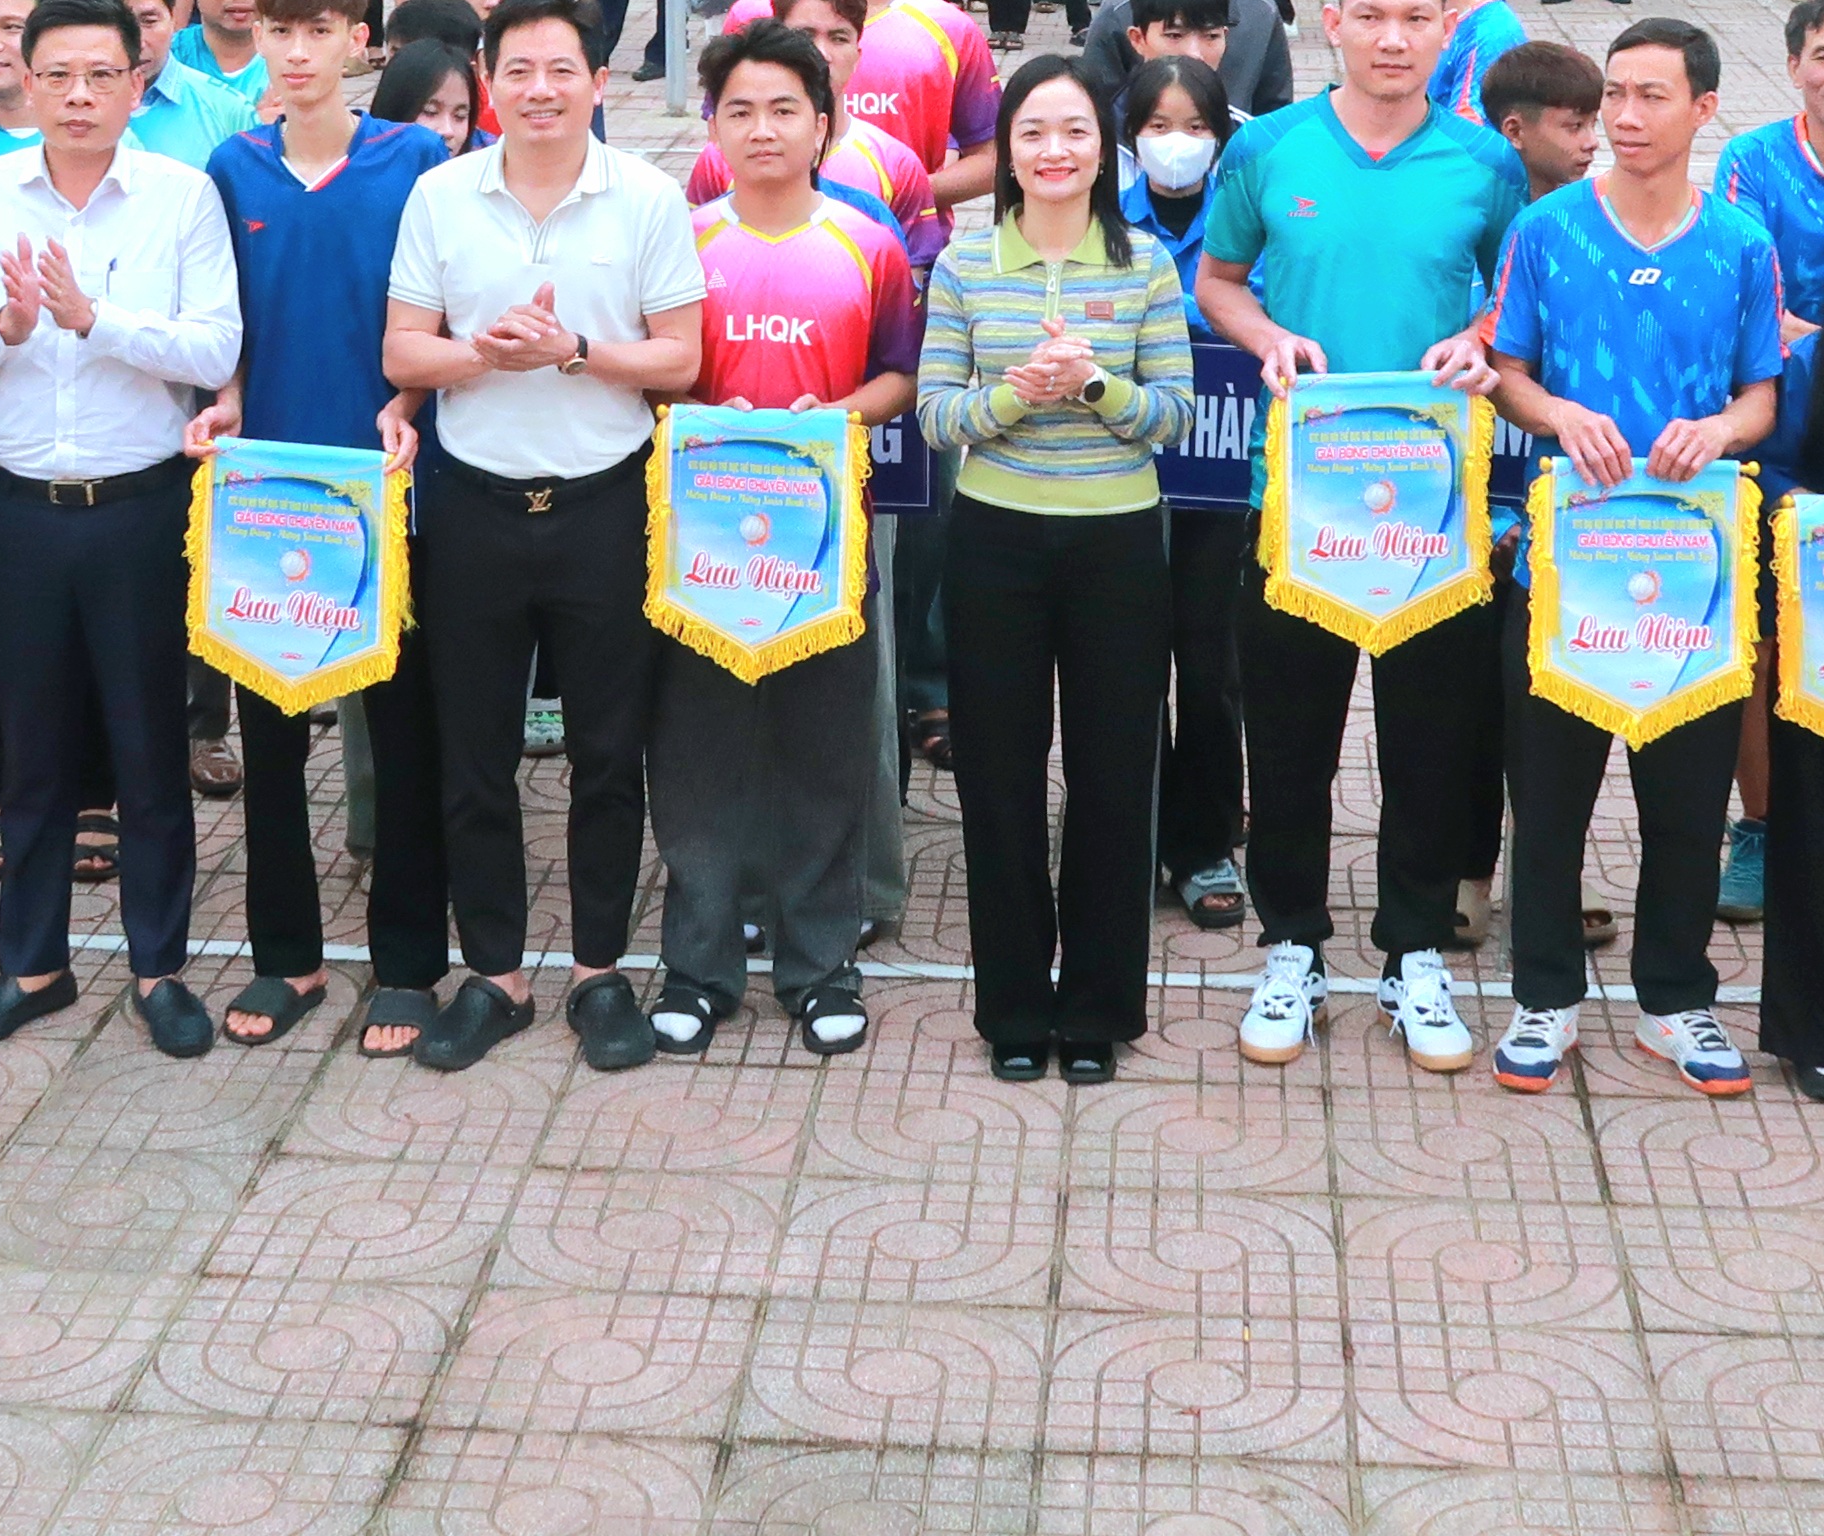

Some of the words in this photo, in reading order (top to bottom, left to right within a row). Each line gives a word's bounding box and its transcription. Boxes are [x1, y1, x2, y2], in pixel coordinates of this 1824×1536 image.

[843, 92, 899, 114] HQK
[726, 314, 815, 345] LHQK
[1309, 525, 1368, 561] Lưu
[1373, 522, 1450, 566] Niệm
[684, 551, 740, 590] Lưu
[747, 553, 822, 600] Niệm
[226, 586, 281, 622] Lưu
[287, 589, 362, 635] Niệm
[1569, 615, 1630, 653] Lưu
[1636, 614, 1714, 660] Niệm
